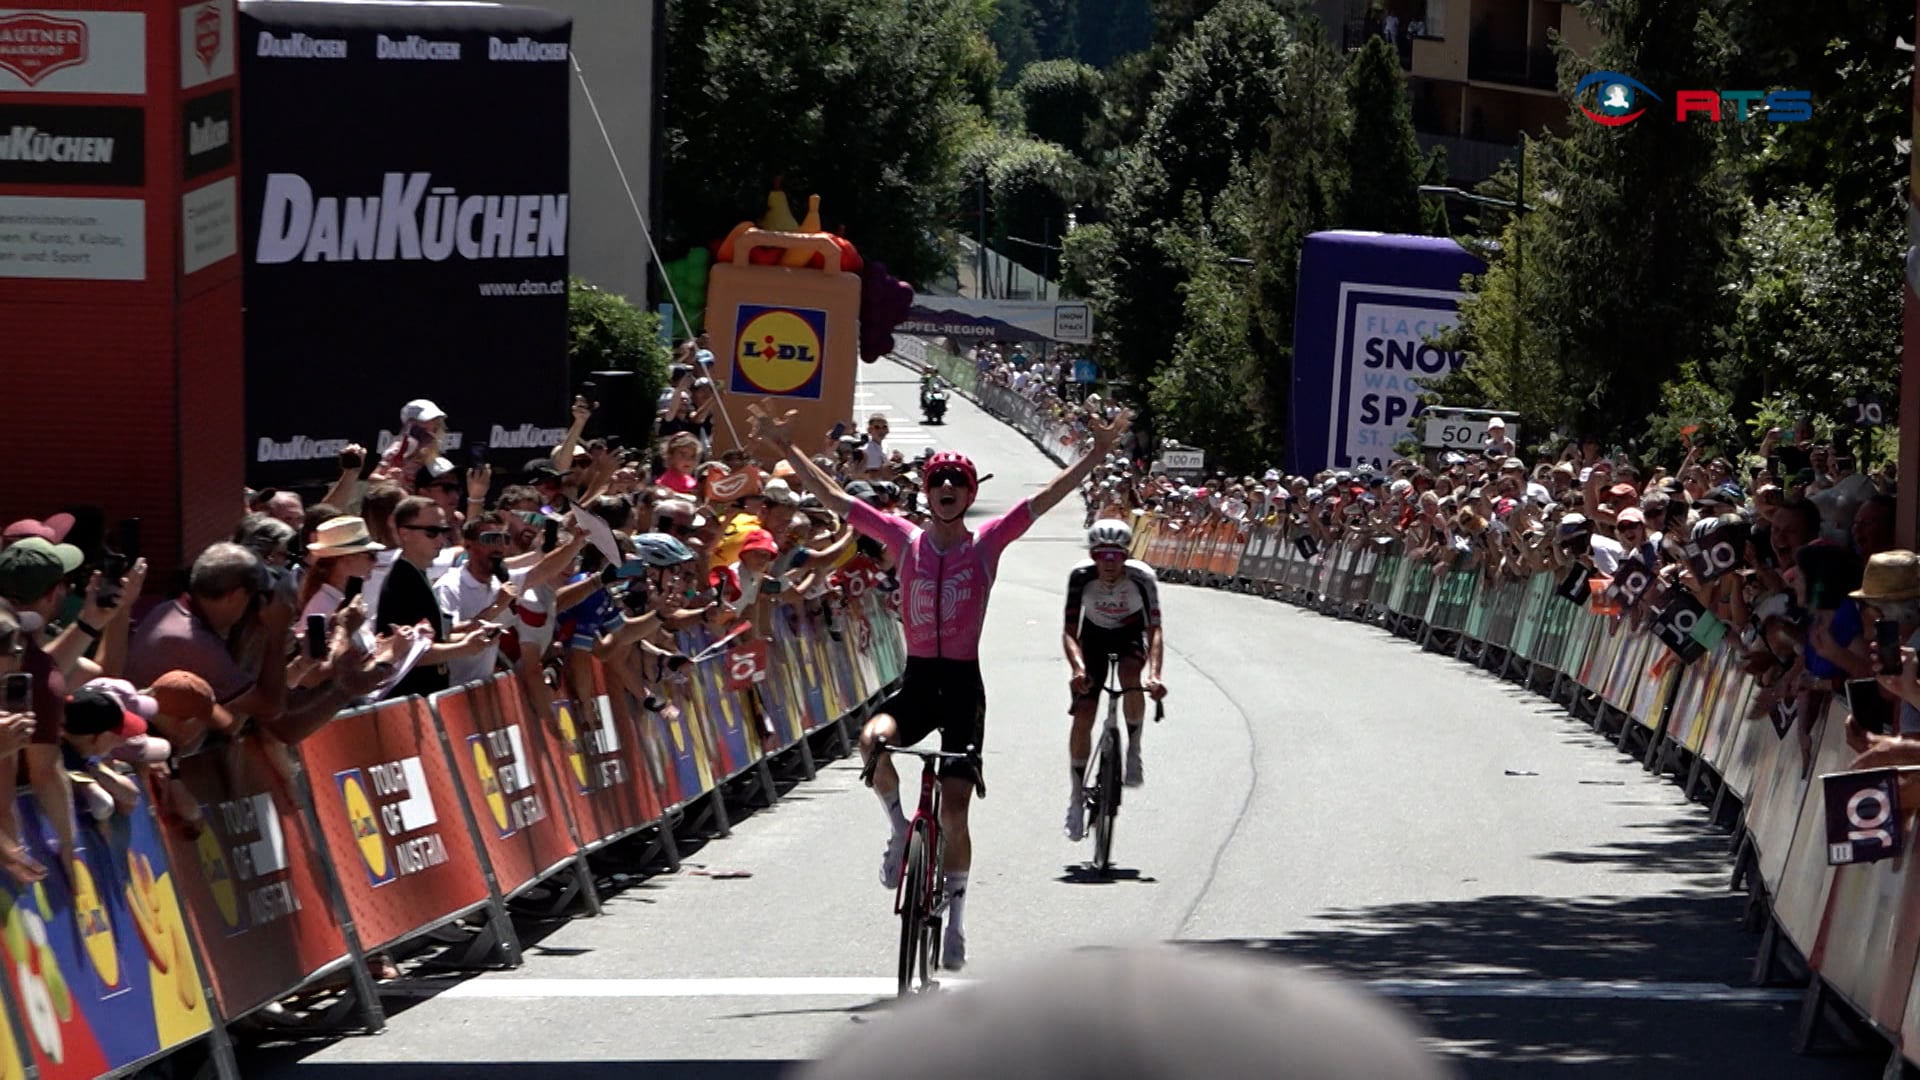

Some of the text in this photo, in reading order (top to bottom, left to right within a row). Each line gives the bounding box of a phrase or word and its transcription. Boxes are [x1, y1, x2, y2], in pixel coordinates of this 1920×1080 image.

[479, 279, 564, 296] www.dan.at
[743, 335, 814, 362] LIDL
[1441, 425, 1472, 444] 50
[1702, 541, 1736, 577] JO
[1620, 571, 1648, 605] JO
[1667, 609, 1698, 645] JO
[1847, 788, 1892, 848] JO
